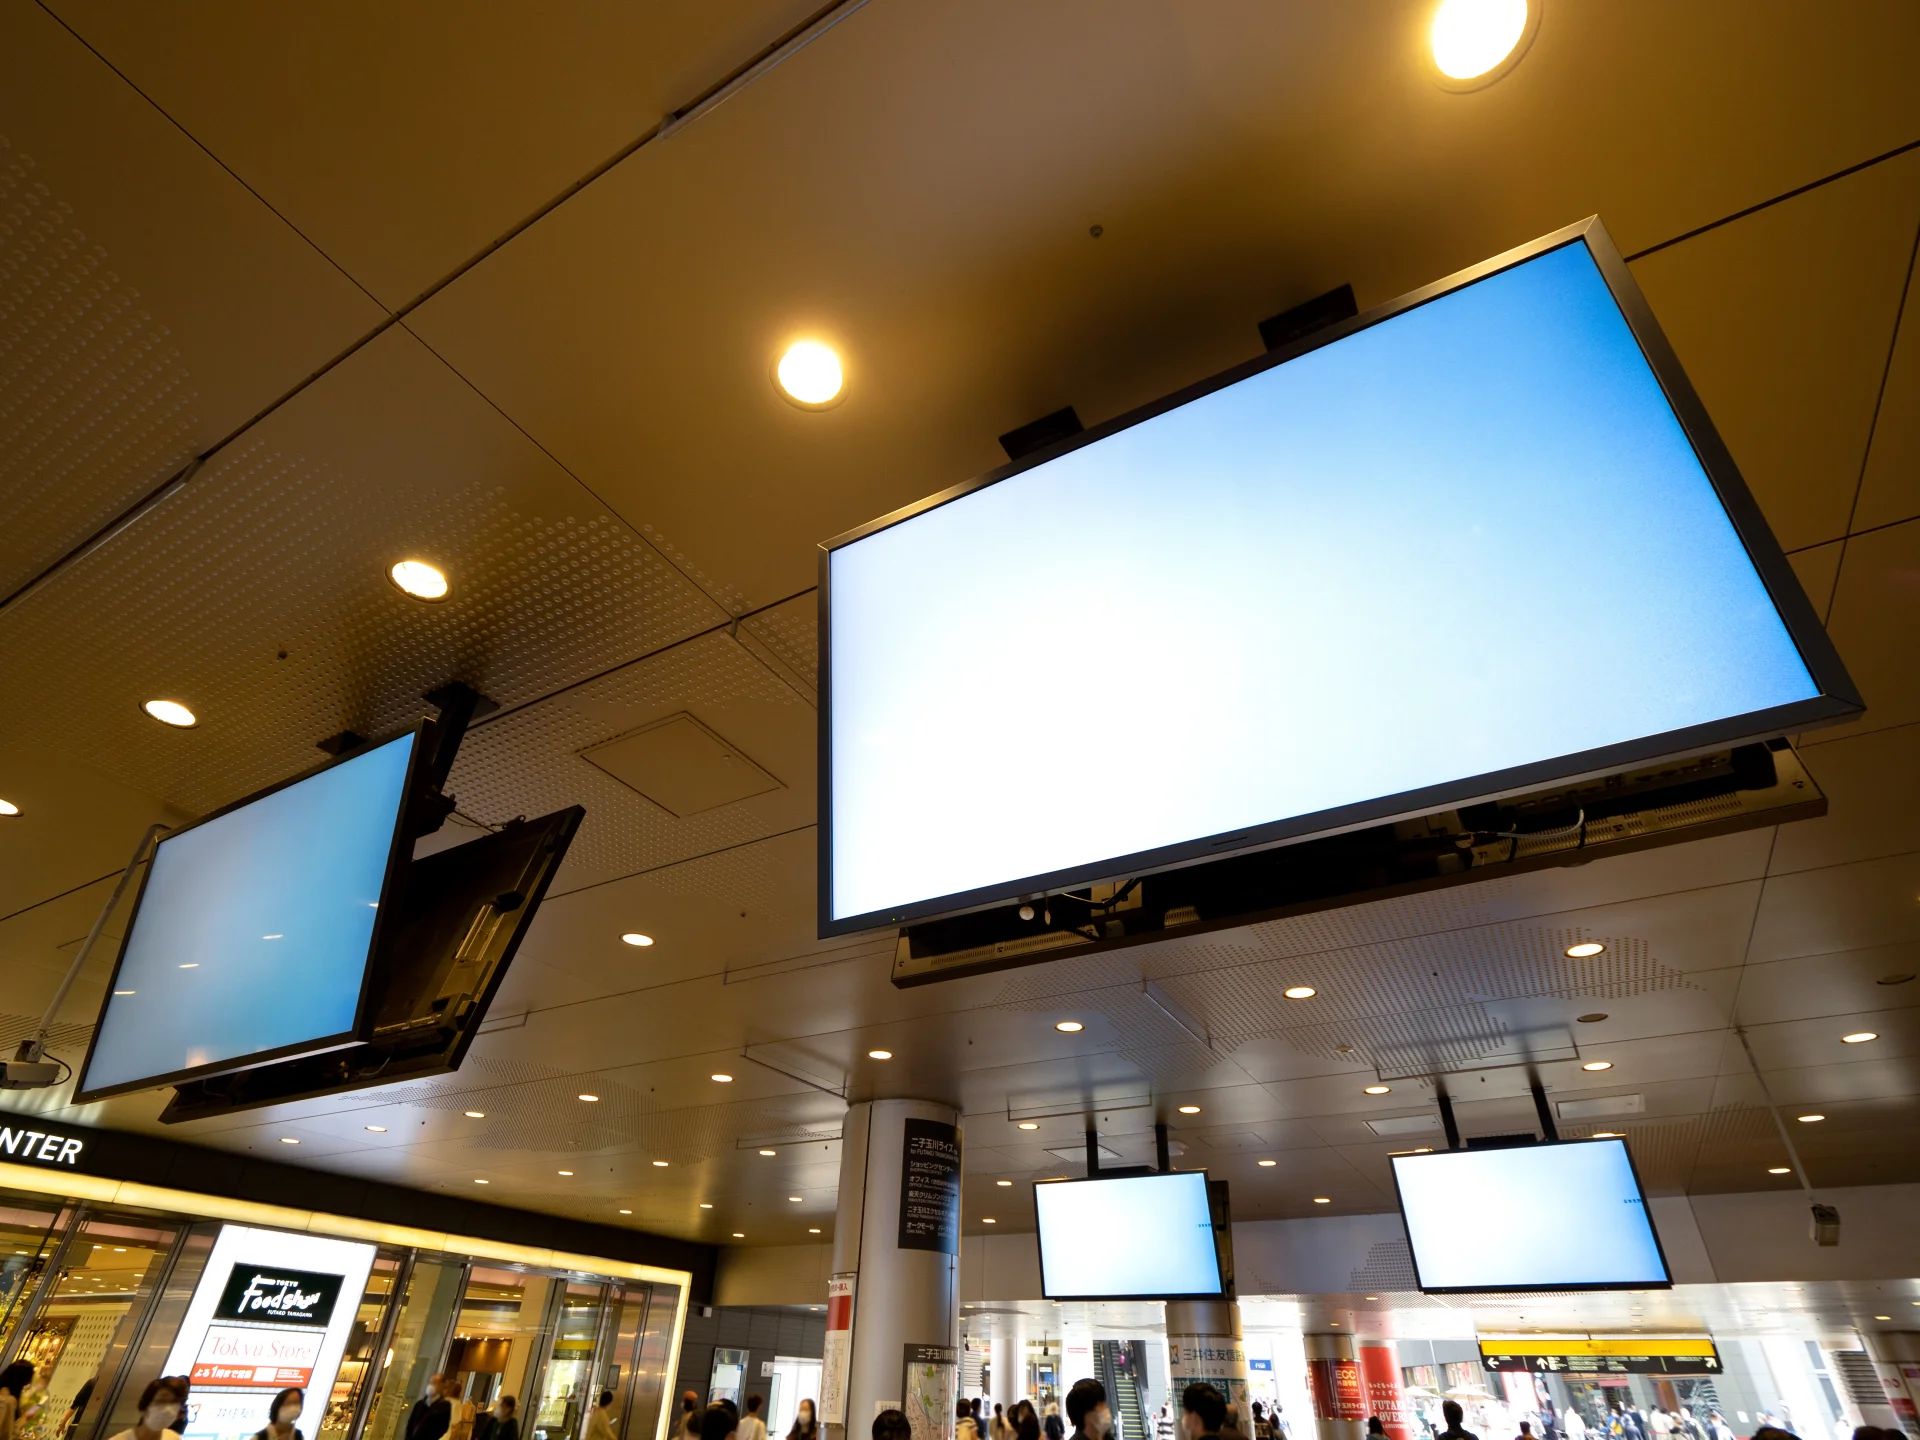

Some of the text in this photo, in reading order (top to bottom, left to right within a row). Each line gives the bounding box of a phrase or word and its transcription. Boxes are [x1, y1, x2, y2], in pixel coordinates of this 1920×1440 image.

[0, 1126, 83, 1164] NTER
[212, 1337, 311, 1359] Tokyu Store
[1336, 1370, 1356, 1380] ECC
